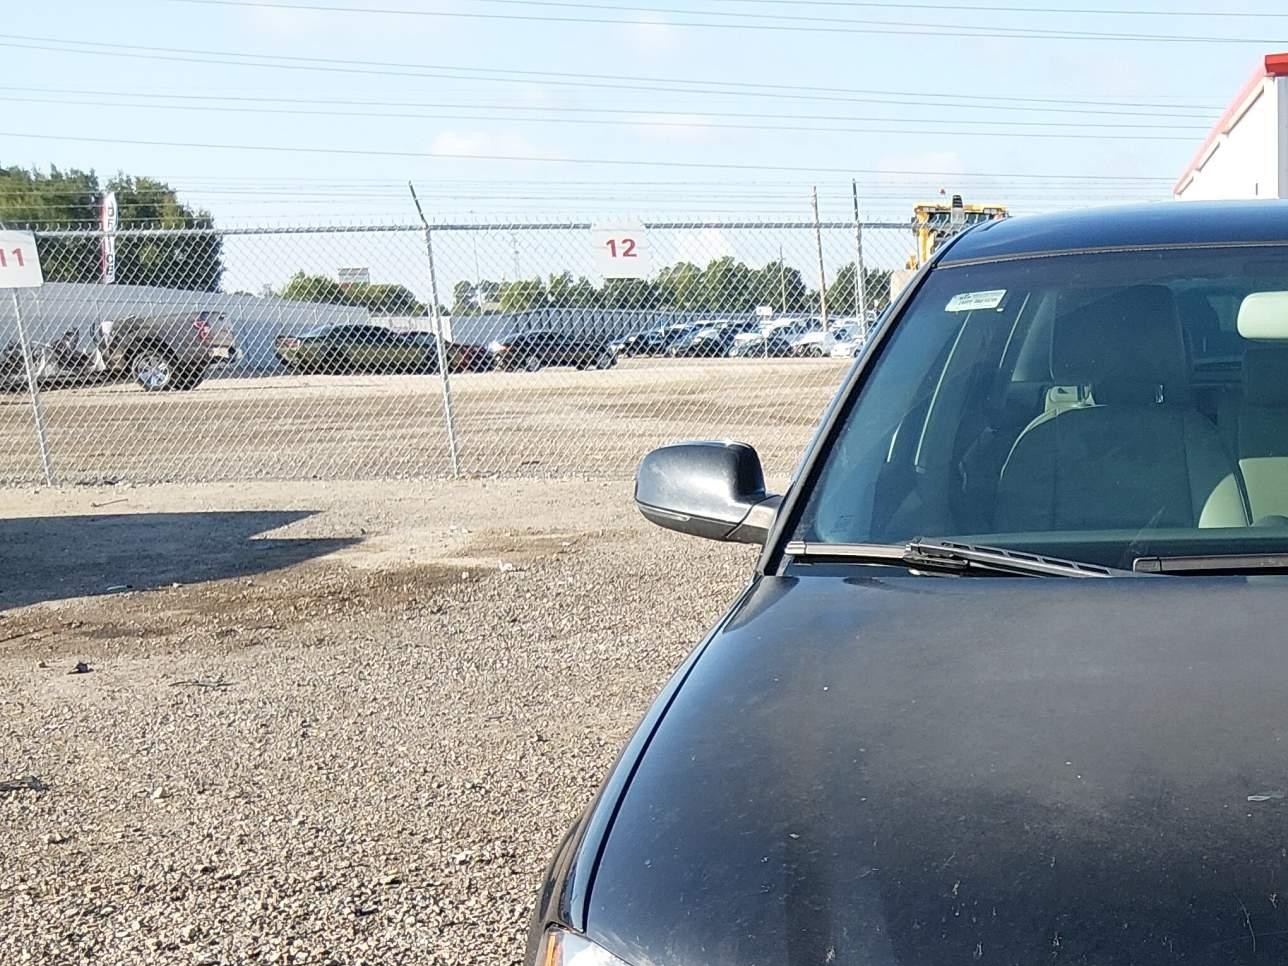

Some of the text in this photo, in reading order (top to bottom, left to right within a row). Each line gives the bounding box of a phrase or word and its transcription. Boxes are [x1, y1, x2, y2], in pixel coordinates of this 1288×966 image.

[106, 206, 116, 276] OFICE
[606, 238, 637, 257] 12
[0, 248, 24, 267] 11
